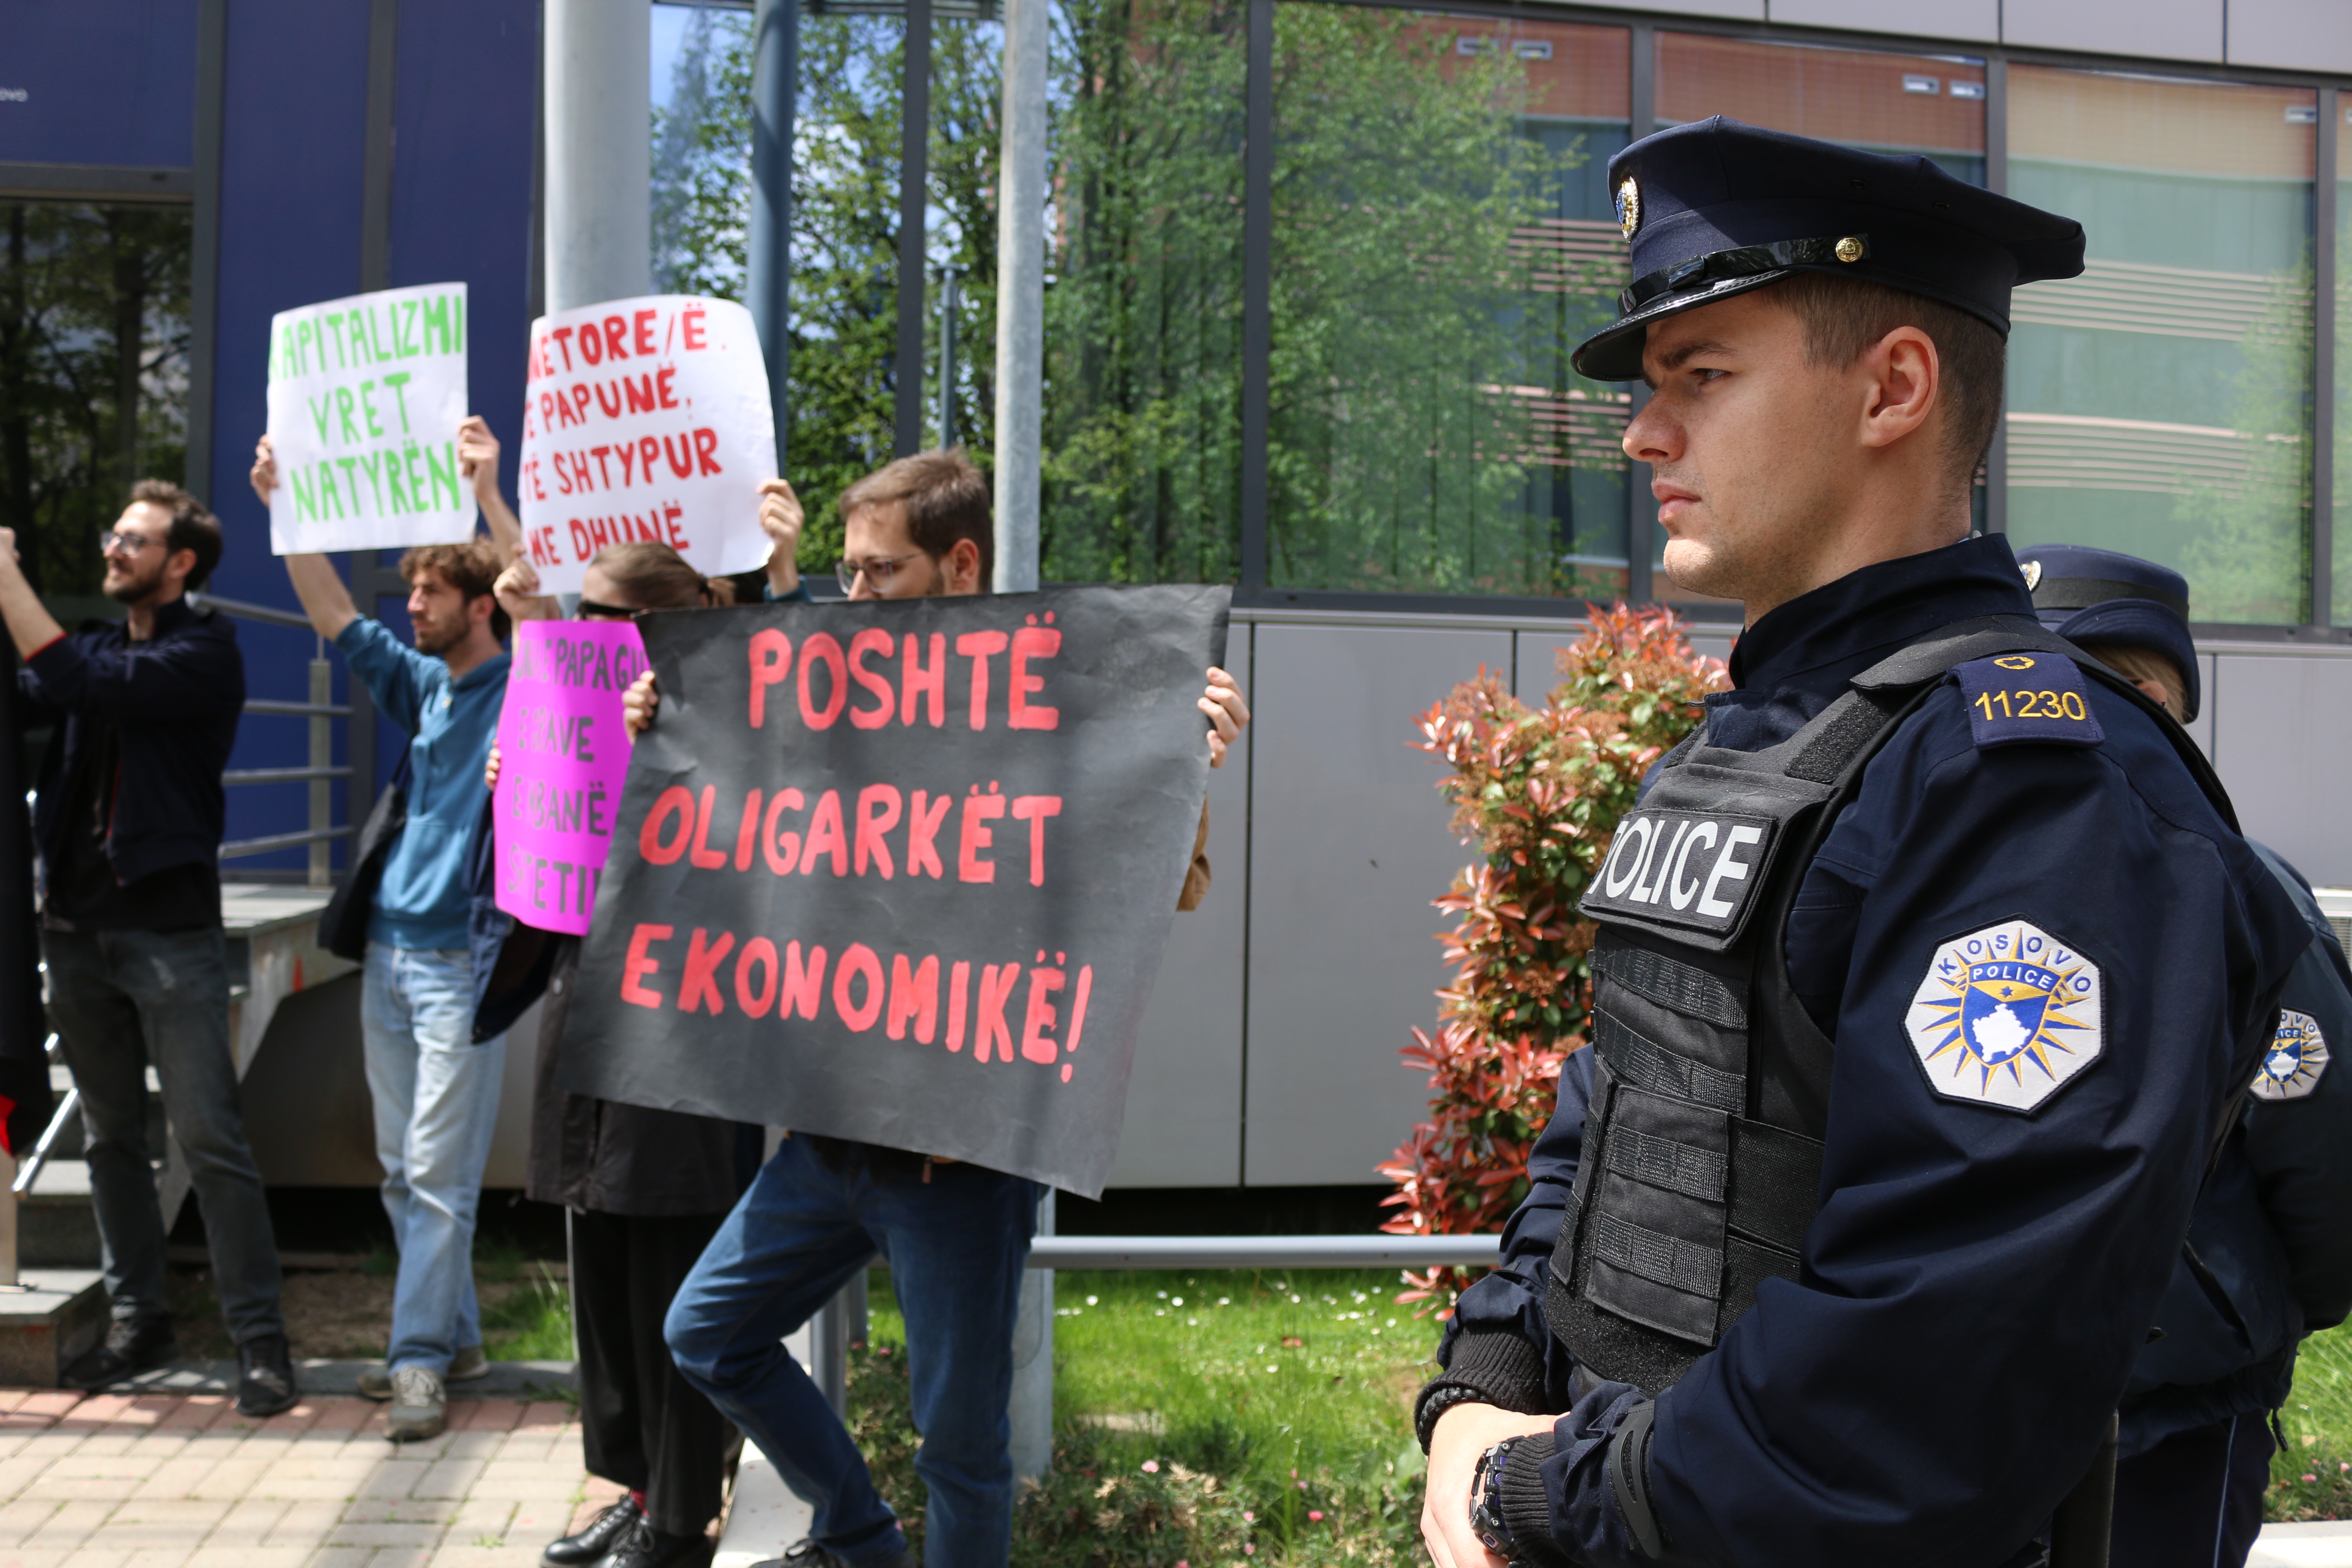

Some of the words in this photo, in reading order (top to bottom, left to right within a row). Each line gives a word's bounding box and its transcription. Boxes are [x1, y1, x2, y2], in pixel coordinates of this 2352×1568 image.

[308, 372, 410, 446] VRET
[291, 439, 461, 523] NATYRËN
[554, 427, 723, 495] SHTYPUR
[748, 610, 1062, 731] POSHTË
[1975, 690, 2086, 720] 11230
[639, 780, 1062, 886] OLIGARKËT
[1587, 817, 1762, 918] POLICE
[1938, 934, 2091, 992] KOSOVO
[1973, 965, 2053, 989] POLICE
[620, 923, 1093, 1083] EKONOMIKË!
[2281, 1012, 2316, 1033] OVO
